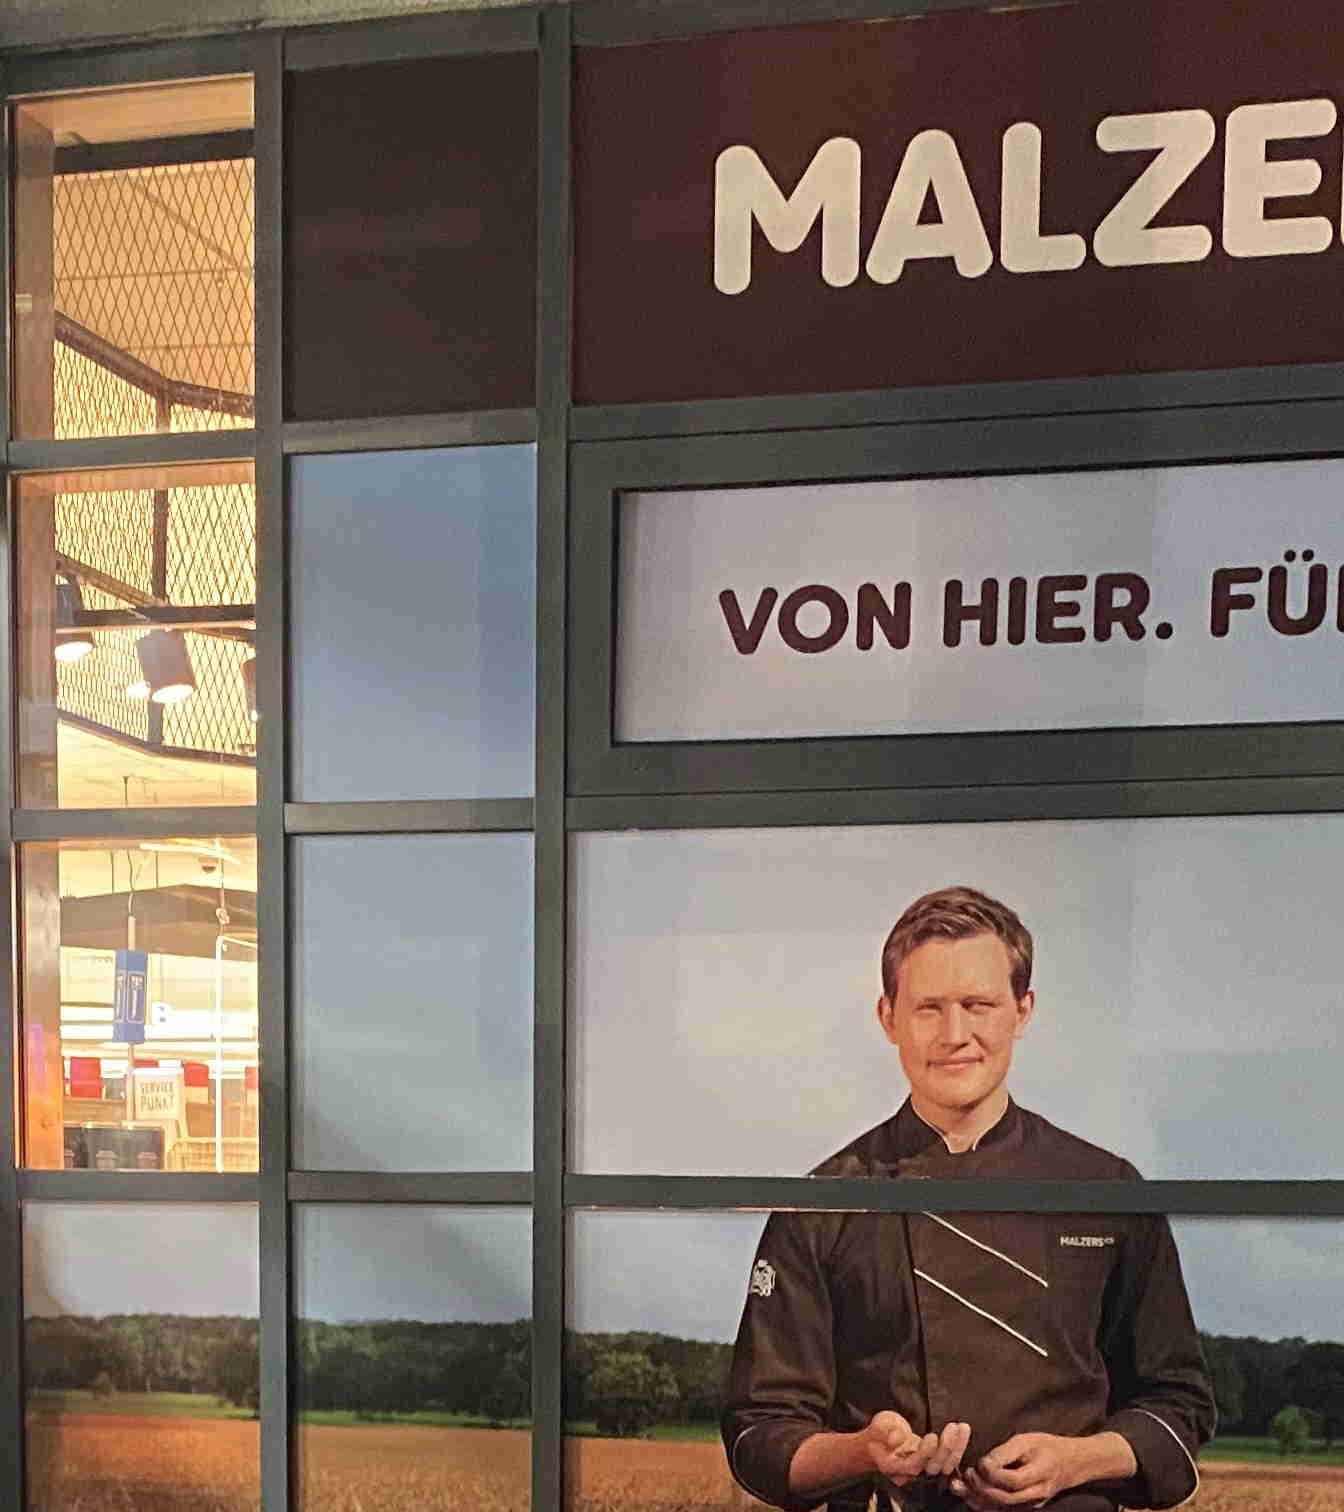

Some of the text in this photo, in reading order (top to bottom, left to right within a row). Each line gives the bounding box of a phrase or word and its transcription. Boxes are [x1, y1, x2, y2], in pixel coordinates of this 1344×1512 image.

[718, 581, 912, 655] VON
[942, 572, 1175, 648] HIER.
[140, 1095, 175, 1112] PUNKT
